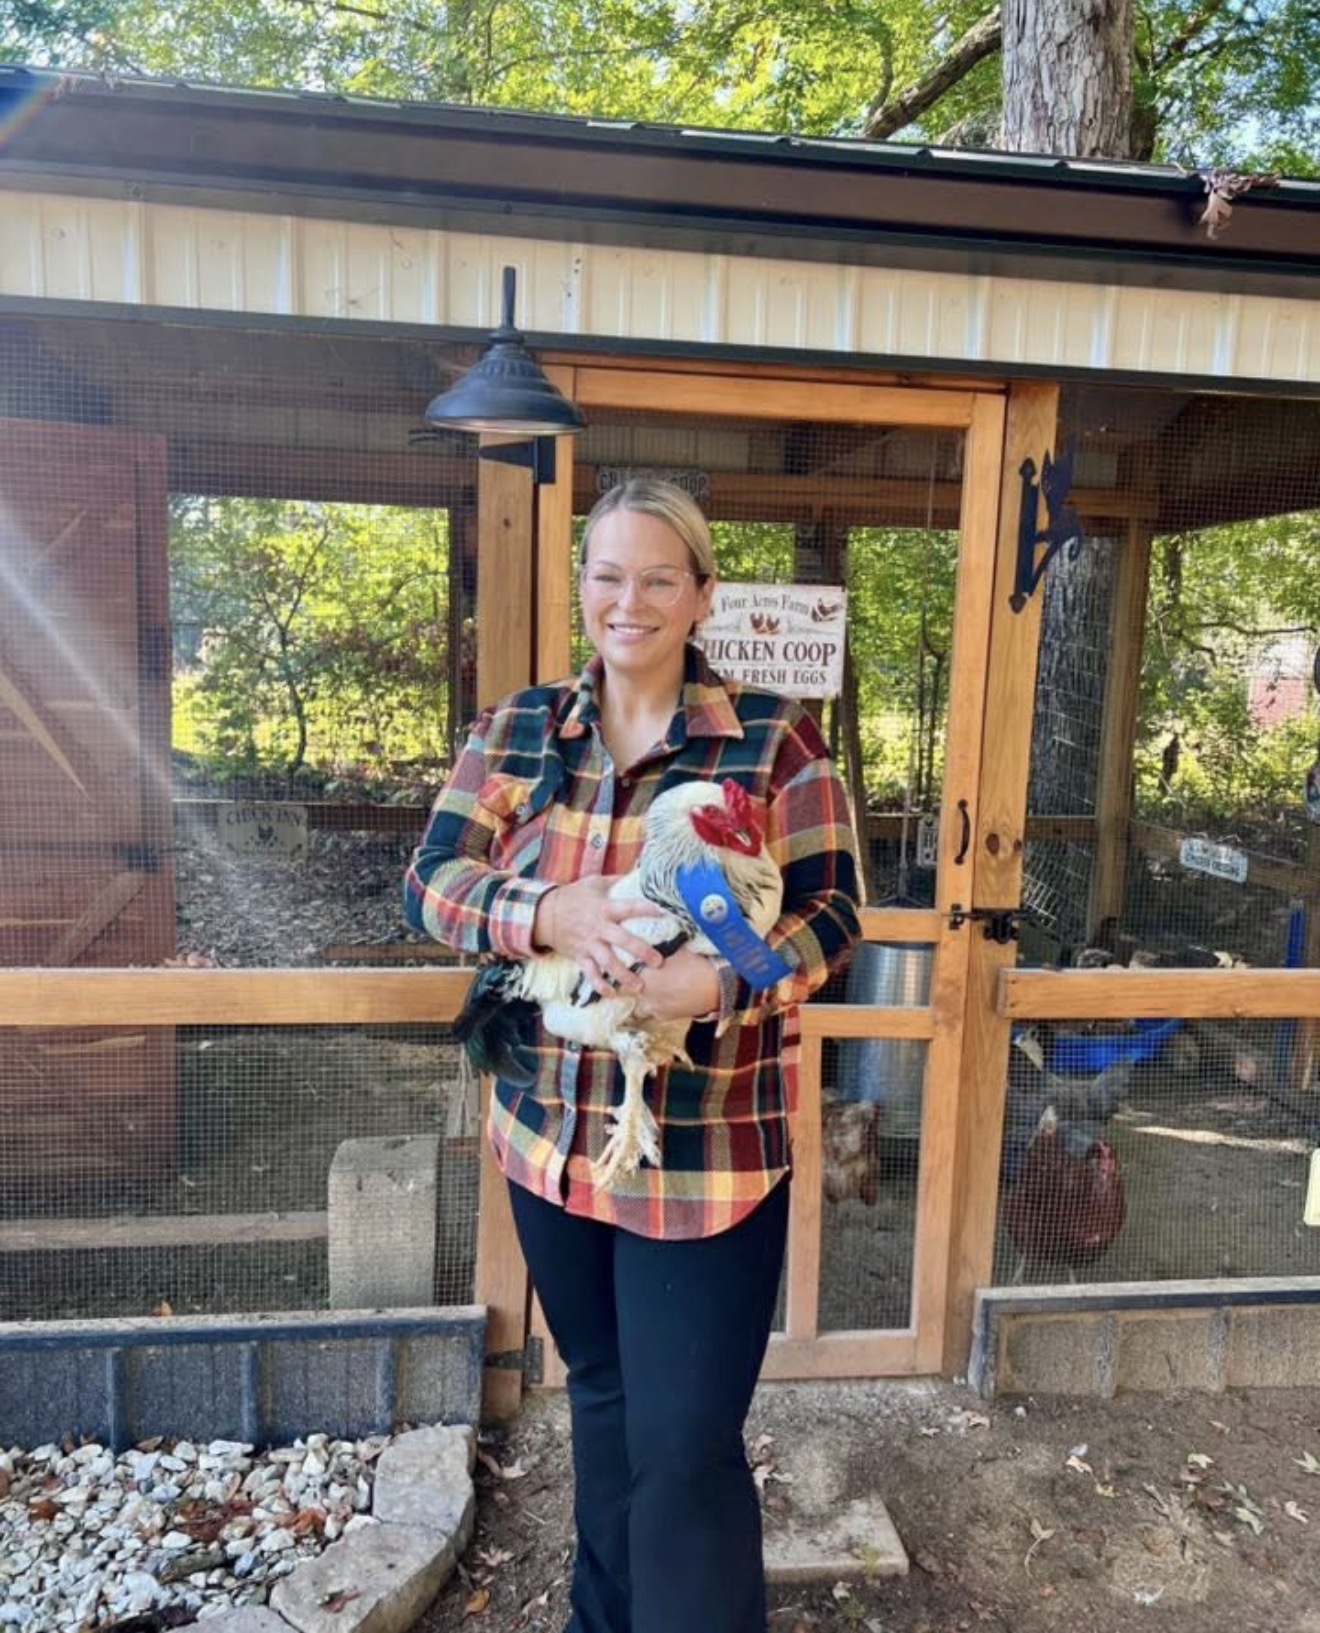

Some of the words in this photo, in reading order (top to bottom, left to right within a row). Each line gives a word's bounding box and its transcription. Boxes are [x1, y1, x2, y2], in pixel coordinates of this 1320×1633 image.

[721, 594, 746, 612] Four
[752, 593, 778, 608] Acres
[703, 639, 775, 661] HICKEN
[782, 643, 837, 666] COOP
[743, 669, 786, 684] FRESH
[794, 670, 827, 685] EGGS
